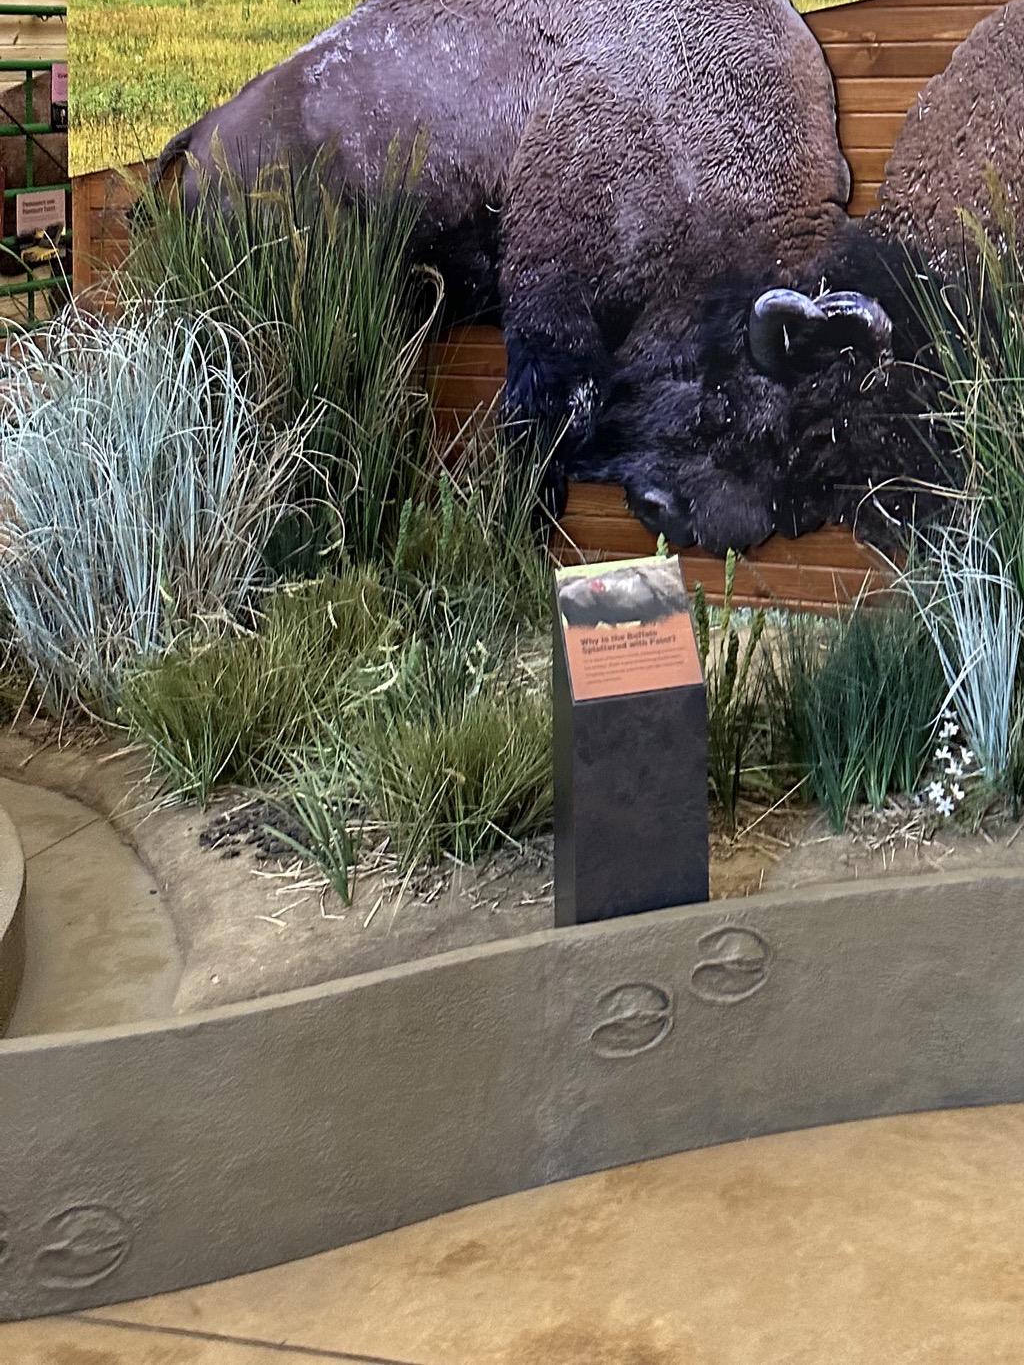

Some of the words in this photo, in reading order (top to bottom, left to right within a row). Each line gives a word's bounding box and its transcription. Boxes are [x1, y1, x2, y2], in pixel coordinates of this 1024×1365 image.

[580, 637, 599, 646] Why
[611, 634, 625, 642] the
[627, 630, 658, 640] Buffalo
[582, 642, 627, 654] Splattered
[629, 639, 648, 648] with
[650, 634, 676, 646] Paint?
